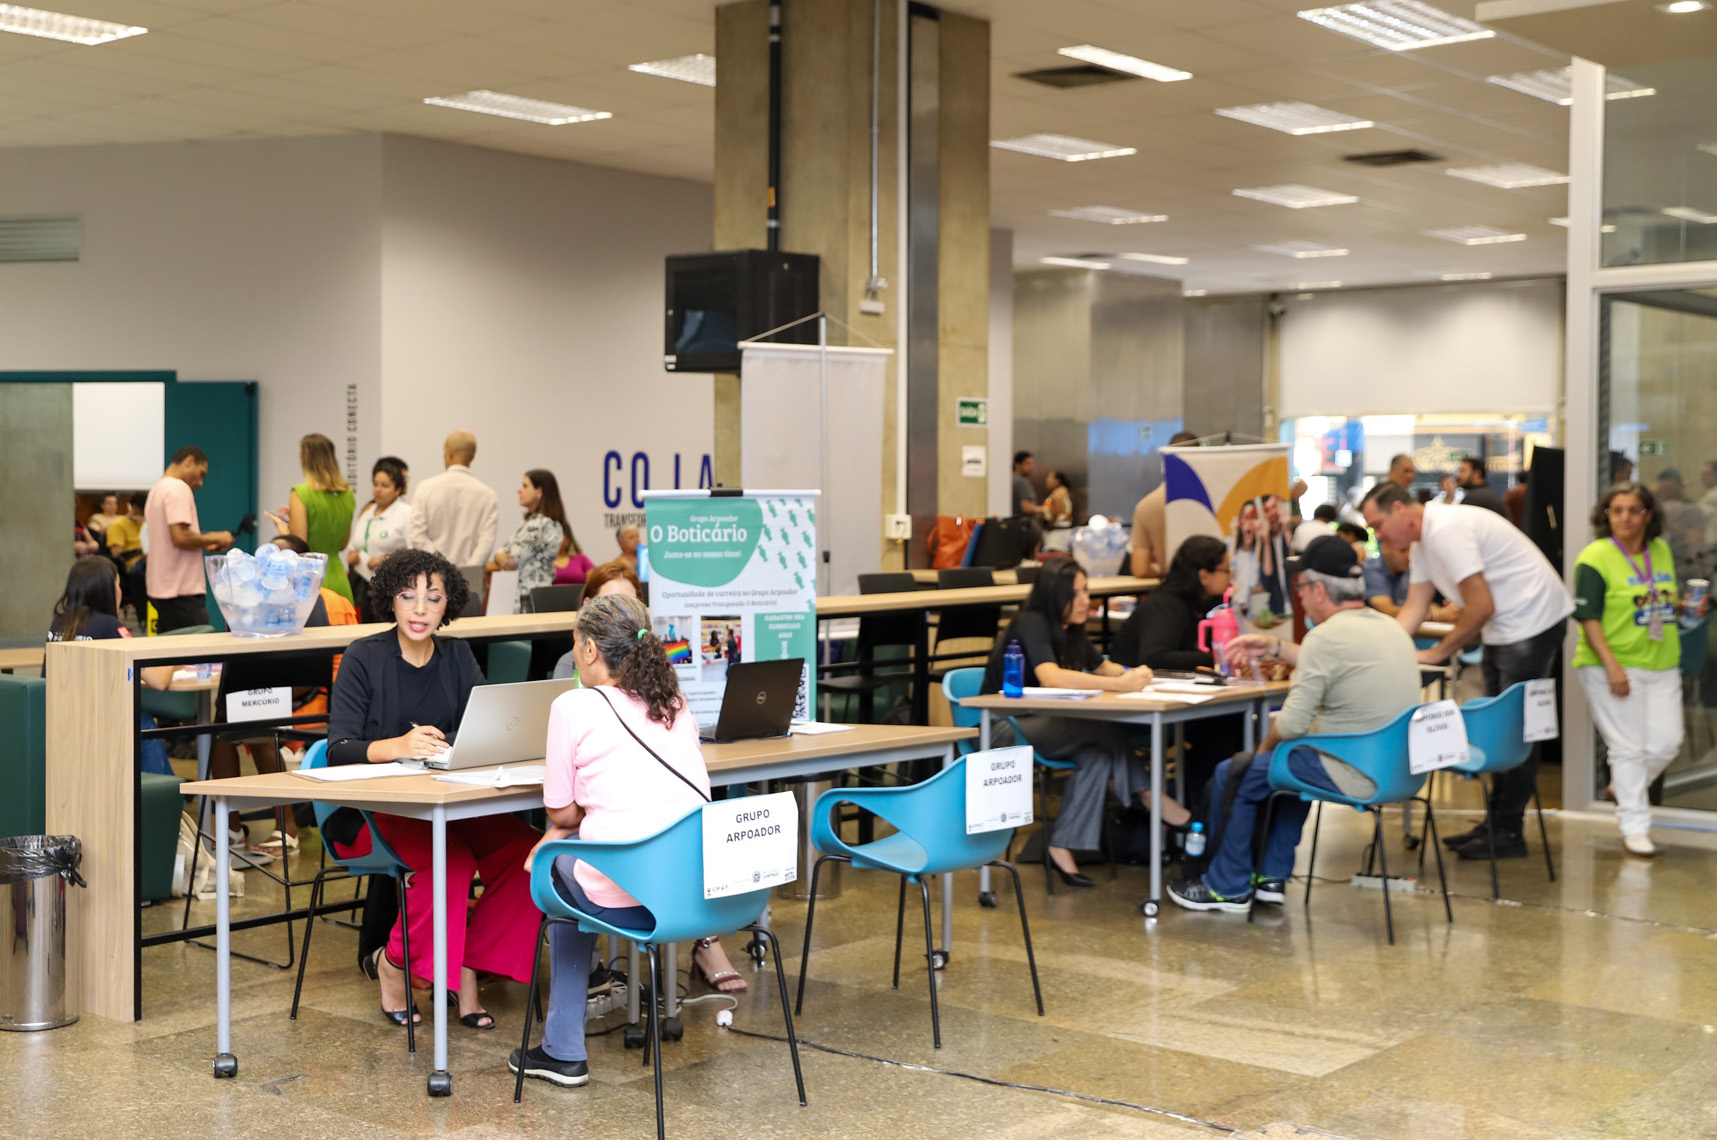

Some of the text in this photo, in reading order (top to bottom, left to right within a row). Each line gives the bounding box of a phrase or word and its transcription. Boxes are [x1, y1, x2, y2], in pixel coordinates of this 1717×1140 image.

[690, 514, 738, 523] Grupo Arpoador
[650, 522, 748, 543] O Boticário
[664, 550, 691, 559] Junte-se
[724, 550, 742, 558] time!
[662, 591, 705, 600] Oportunidade
[751, 590, 769, 598] Grupo
[770, 589, 798, 598] Arpoador
[990, 760, 1016, 771] GRUPO
[983, 774, 1022, 787] ARPOADOR
[735, 809, 770, 824] GRUPO
[726, 825, 781, 843] ARPOADOR
